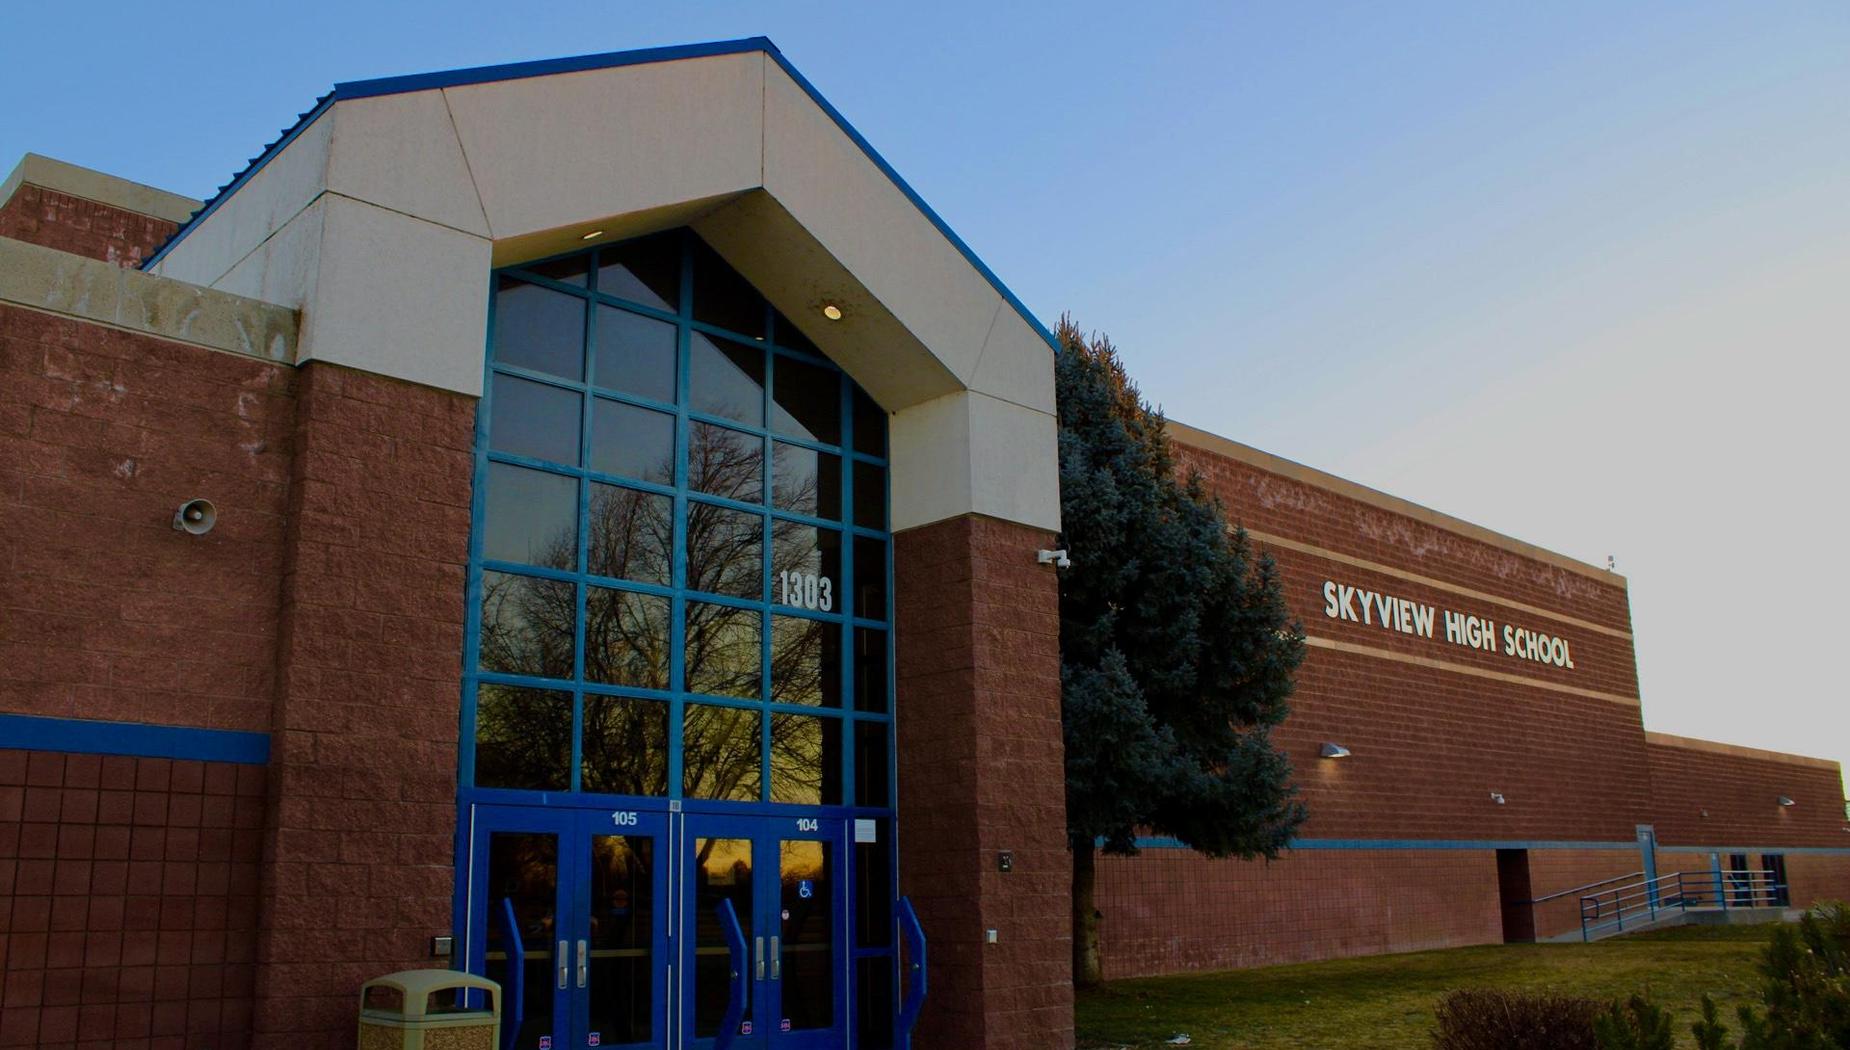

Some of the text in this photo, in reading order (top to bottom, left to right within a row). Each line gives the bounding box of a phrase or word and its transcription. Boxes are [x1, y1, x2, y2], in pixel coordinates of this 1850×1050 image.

[780, 570, 832, 611] 1303
[1323, 581, 1574, 668] SKYVIEW HIGH SCHOOL
[612, 811, 637, 825] 105
[796, 818, 818, 831] 104
